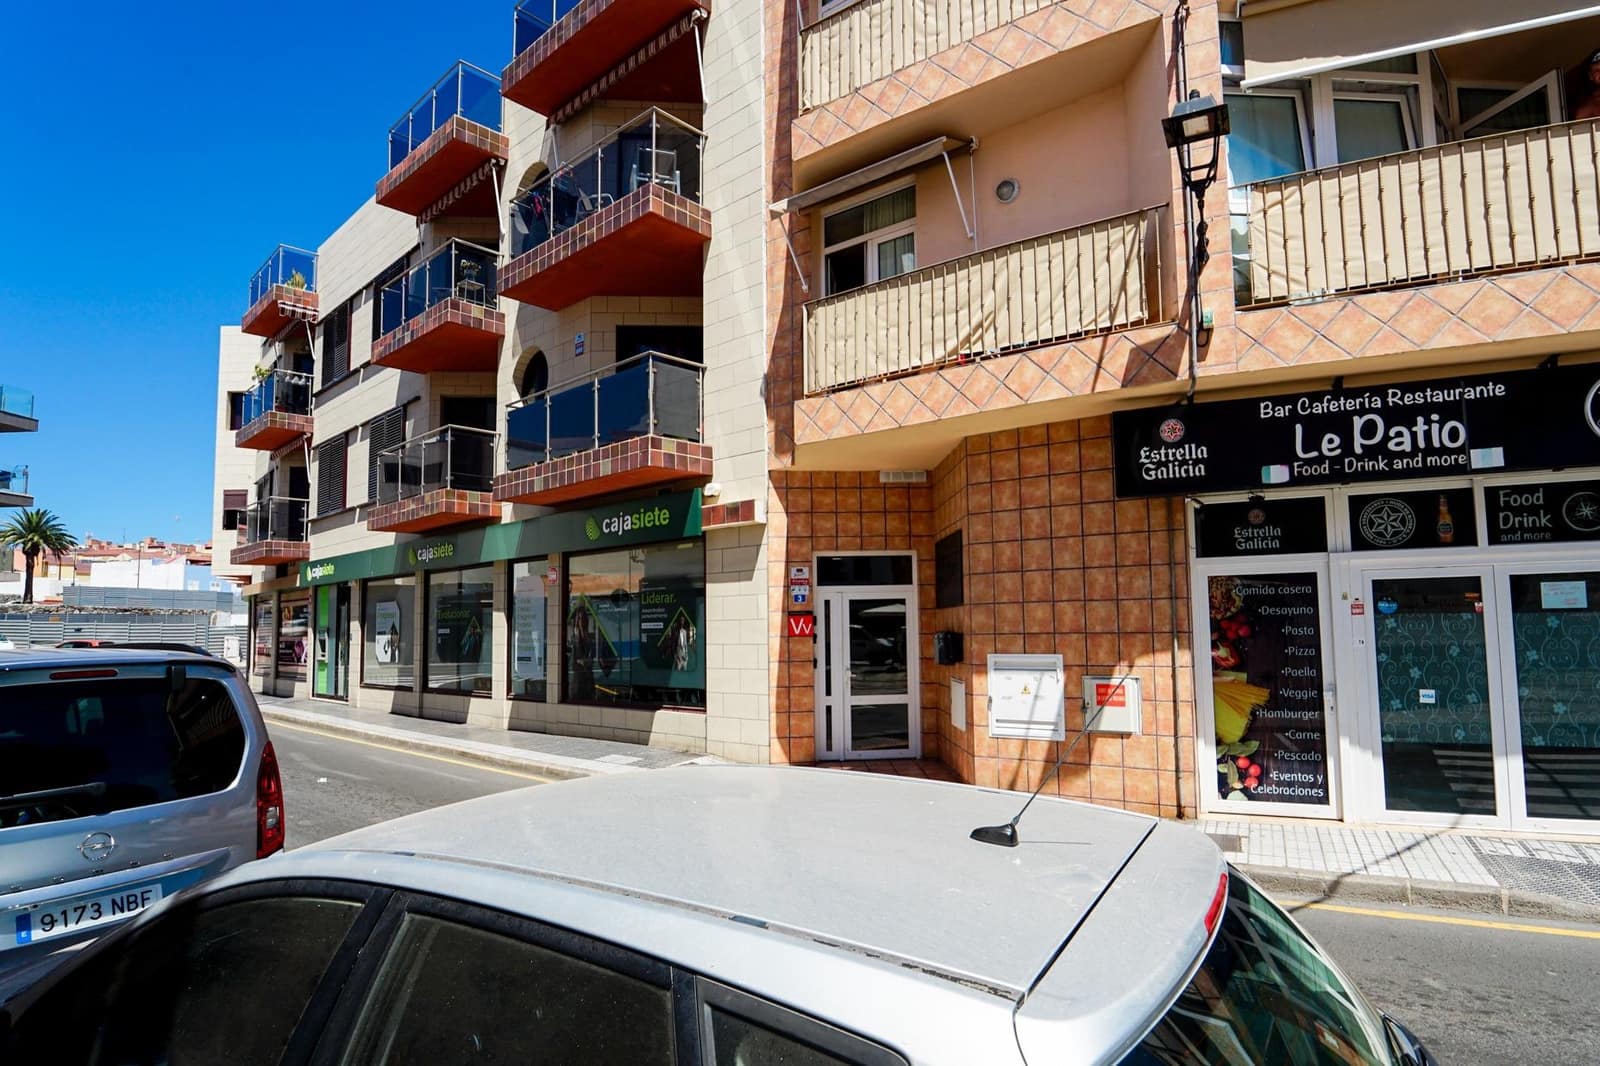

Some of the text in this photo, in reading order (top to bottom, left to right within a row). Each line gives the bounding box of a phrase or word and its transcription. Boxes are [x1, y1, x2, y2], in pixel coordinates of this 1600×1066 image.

[1259, 381, 1507, 418] Bar Cafetería Restaurante
[1295, 412, 1466, 459] Le Patio
[1138, 443, 1208, 464] Estrella
[1142, 460, 1206, 481] Galicia
[1293, 459, 1330, 476] Food
[1344, 455, 1390, 473] Drink
[1393, 452, 1422, 470] and
[1427, 453, 1468, 467] more
[1498, 486, 1544, 507] Food
[602, 506, 671, 536] cajasiete
[1498, 508, 1553, 529] Drink
[1233, 525, 1281, 538] Estrella
[1501, 531, 1552, 542] and more
[1235, 537, 1280, 550] Galicia
[417, 540, 454, 563] cajasiete
[1235, 585, 1312, 596] Comida casera
[1261, 605, 1314, 617] Desayuno
[1285, 626, 1314, 636] Pasta
[1288, 646, 1316, 657] Pizza
[1285, 666, 1317, 677] Paella
[1281, 688, 1318, 700] Veggie
[1259, 708, 1320, 720] Hamburger
[1288, 729, 1321, 740] Carne
[1277, 750, 1322, 762] Pescado
[1273, 771, 1324, 785] Eventos y
[1250, 783, 1324, 797] Celebraciones
[40, 889, 153, 933] 9173 NBF
